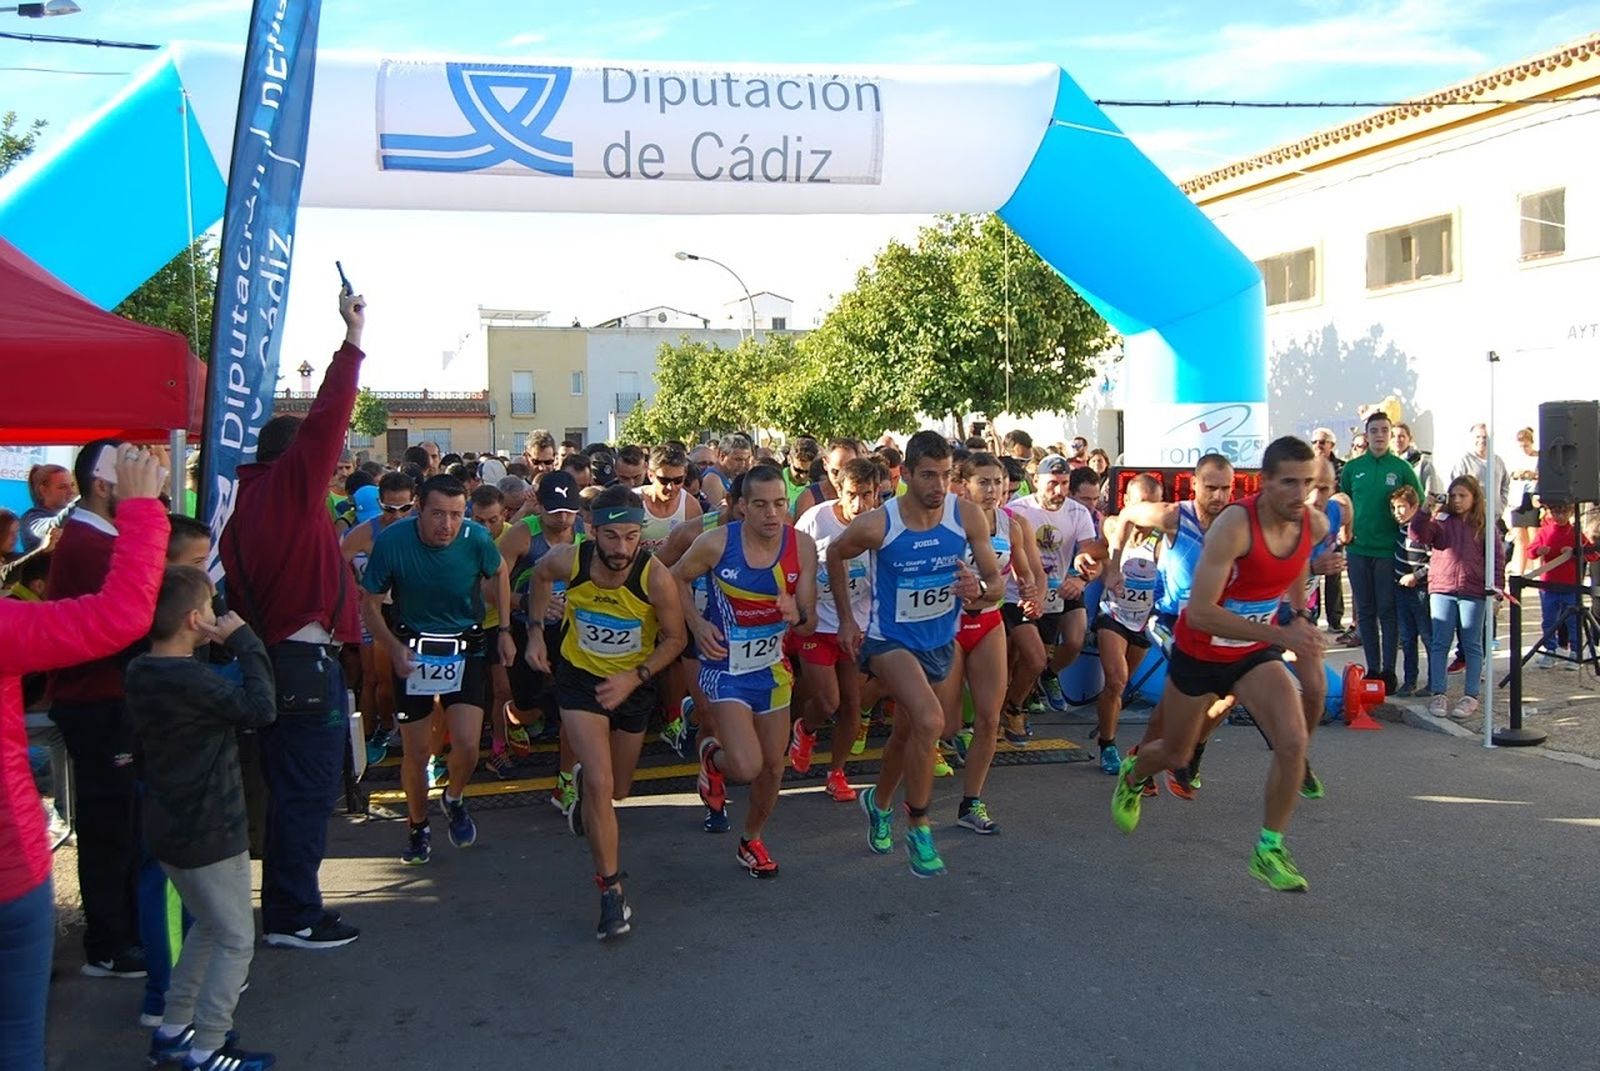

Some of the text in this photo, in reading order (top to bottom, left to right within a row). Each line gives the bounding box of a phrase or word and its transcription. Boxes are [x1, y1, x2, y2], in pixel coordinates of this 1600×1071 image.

[602, 67, 881, 113] Diputación
[603, 130, 832, 184] de Cádiz
[909, 585, 950, 608] 165
[1120, 589, 1148, 602] 24
[586, 625, 631, 645] 322
[742, 635, 778, 658] 129
[417, 663, 456, 680] 128
